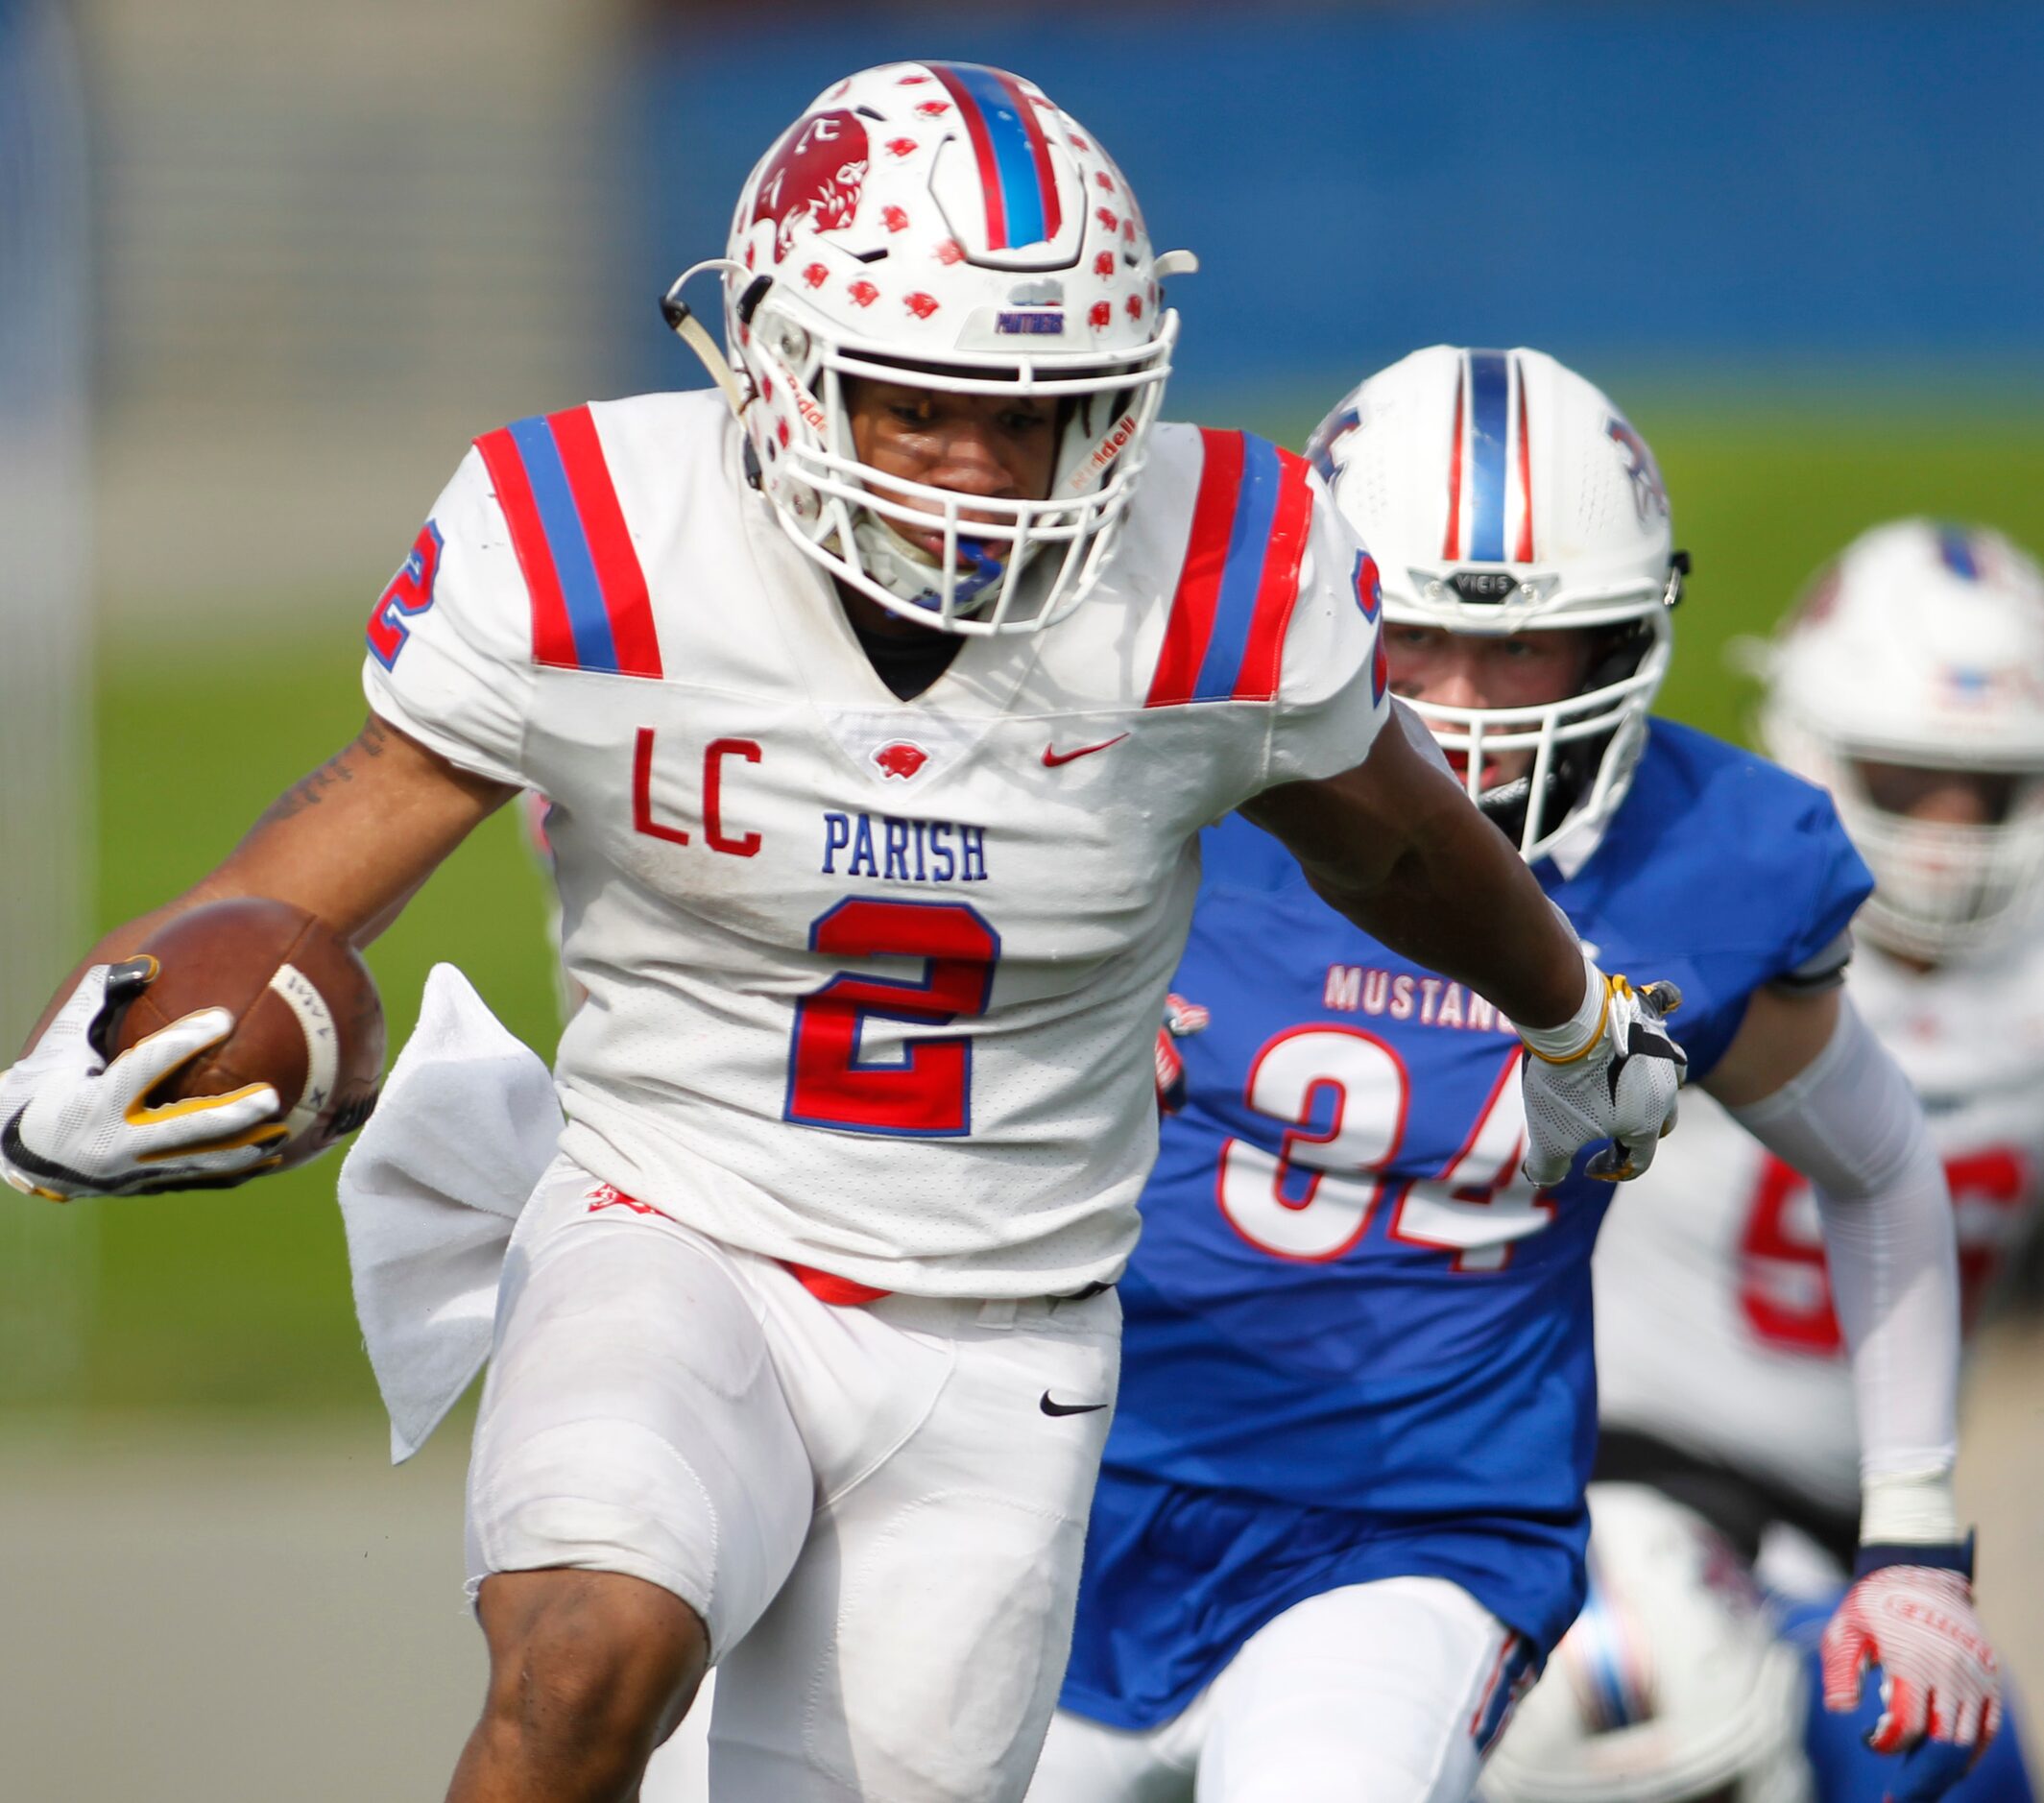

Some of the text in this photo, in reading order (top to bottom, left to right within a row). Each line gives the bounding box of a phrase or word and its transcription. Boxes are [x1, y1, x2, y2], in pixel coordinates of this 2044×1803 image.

[365, 517, 445, 673] 2
[633, 728, 762, 857] LC
[822, 813, 989, 881] PARISH
[782, 895, 1001, 1137] 2
[1215, 1022, 1557, 1273] 34
